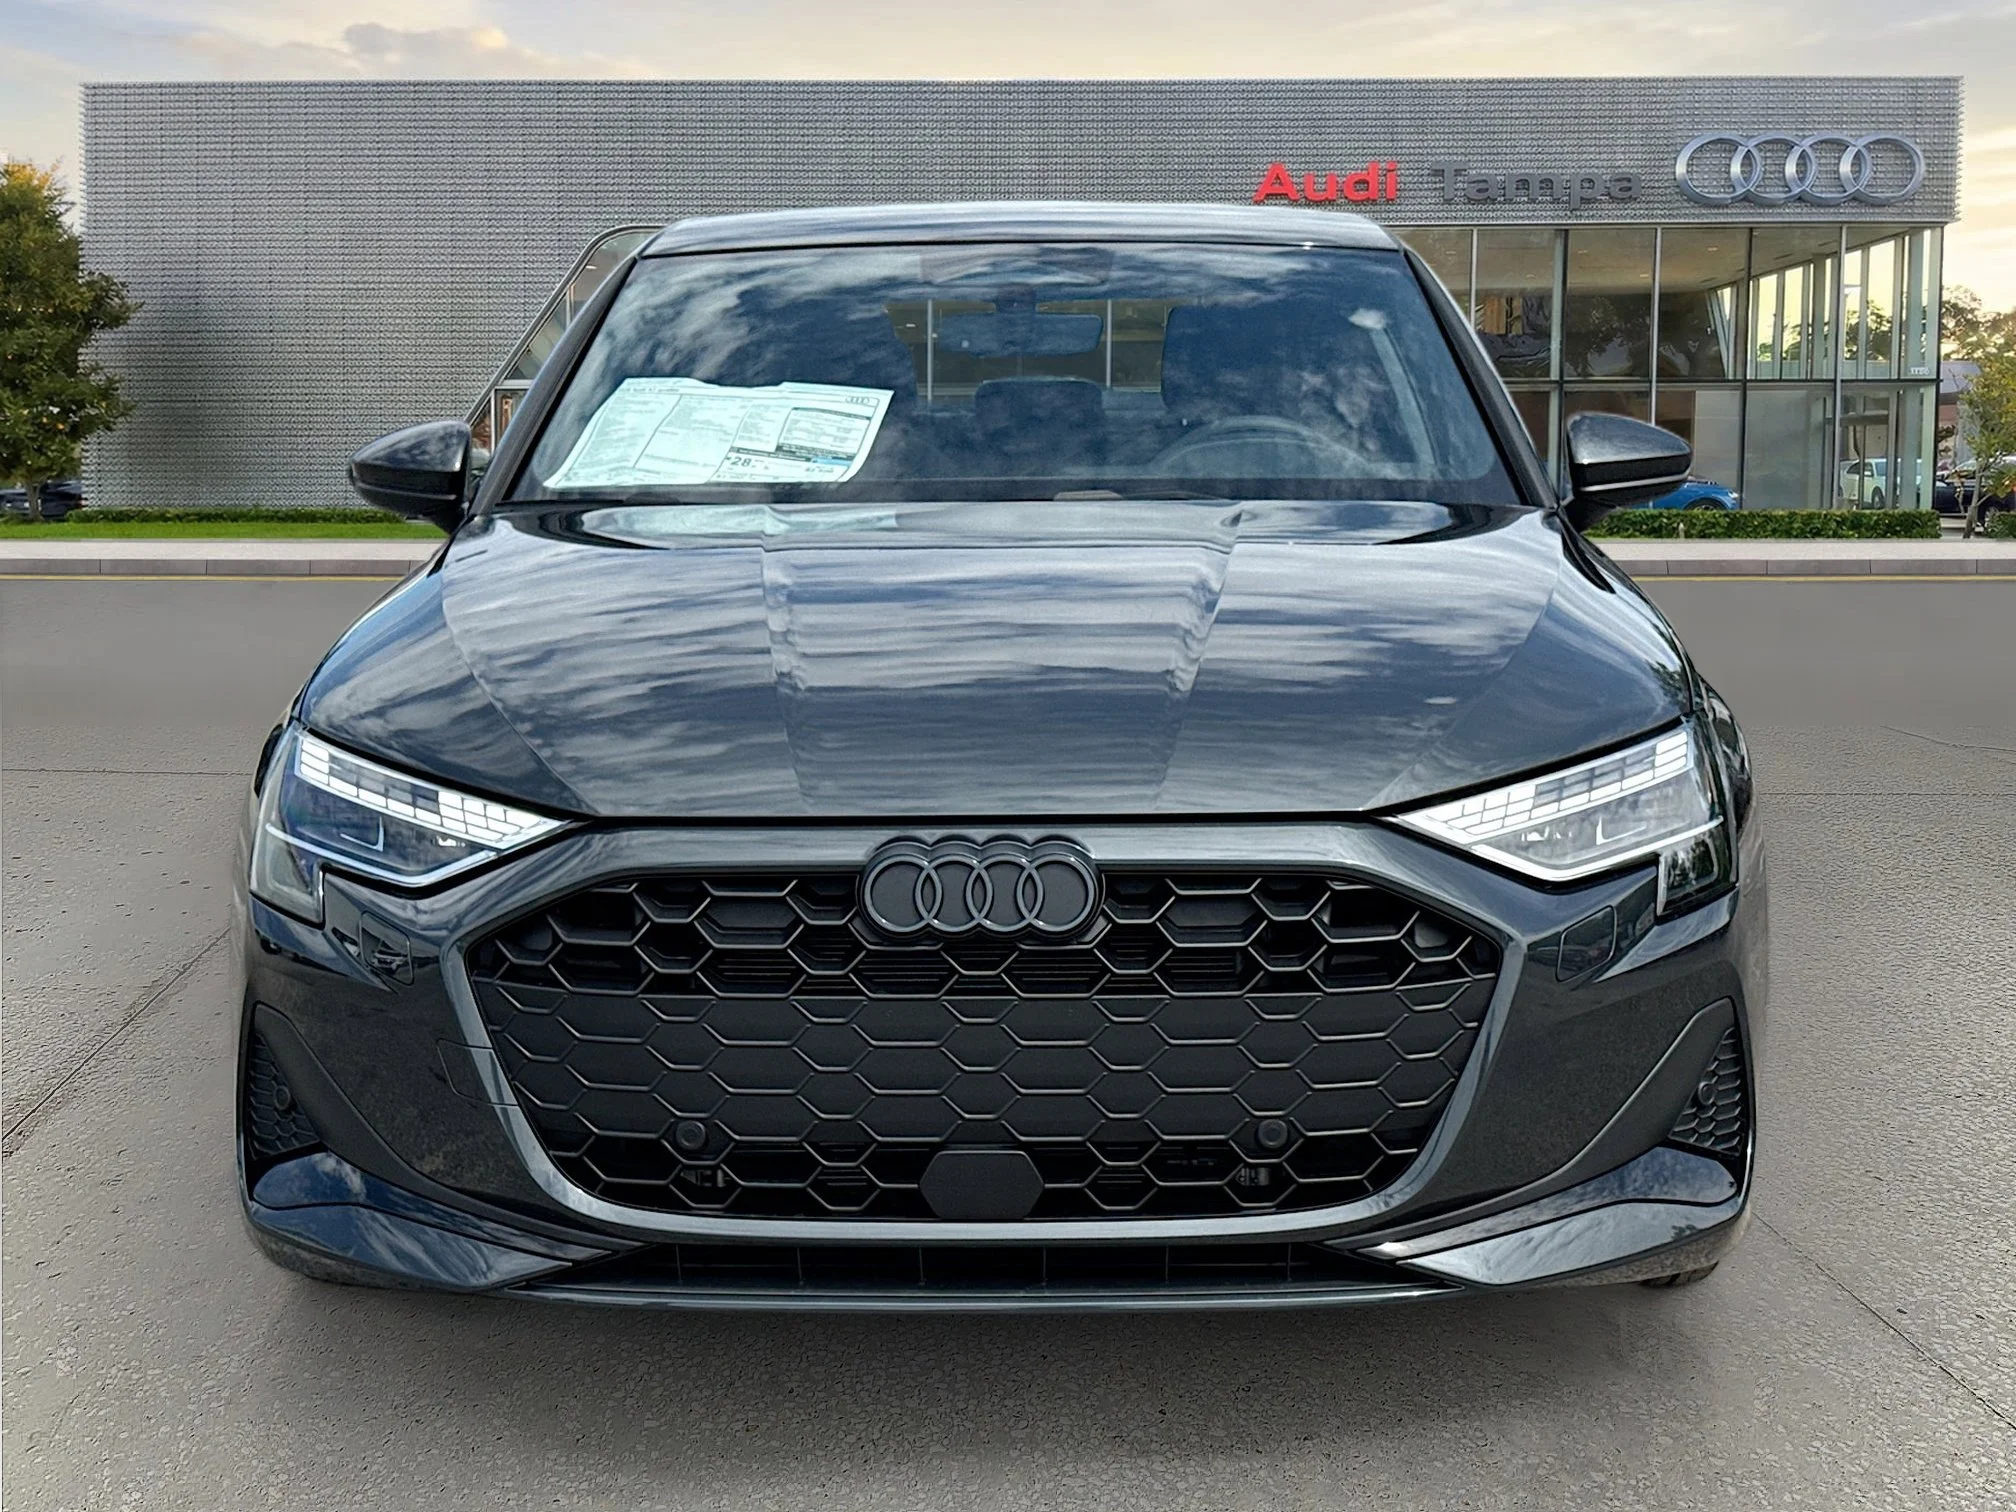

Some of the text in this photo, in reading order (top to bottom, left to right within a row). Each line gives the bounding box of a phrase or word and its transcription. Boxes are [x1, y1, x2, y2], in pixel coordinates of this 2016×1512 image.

[1254, 161, 1642, 211] Audi Tampa
[731, 457, 752, 467] 28
